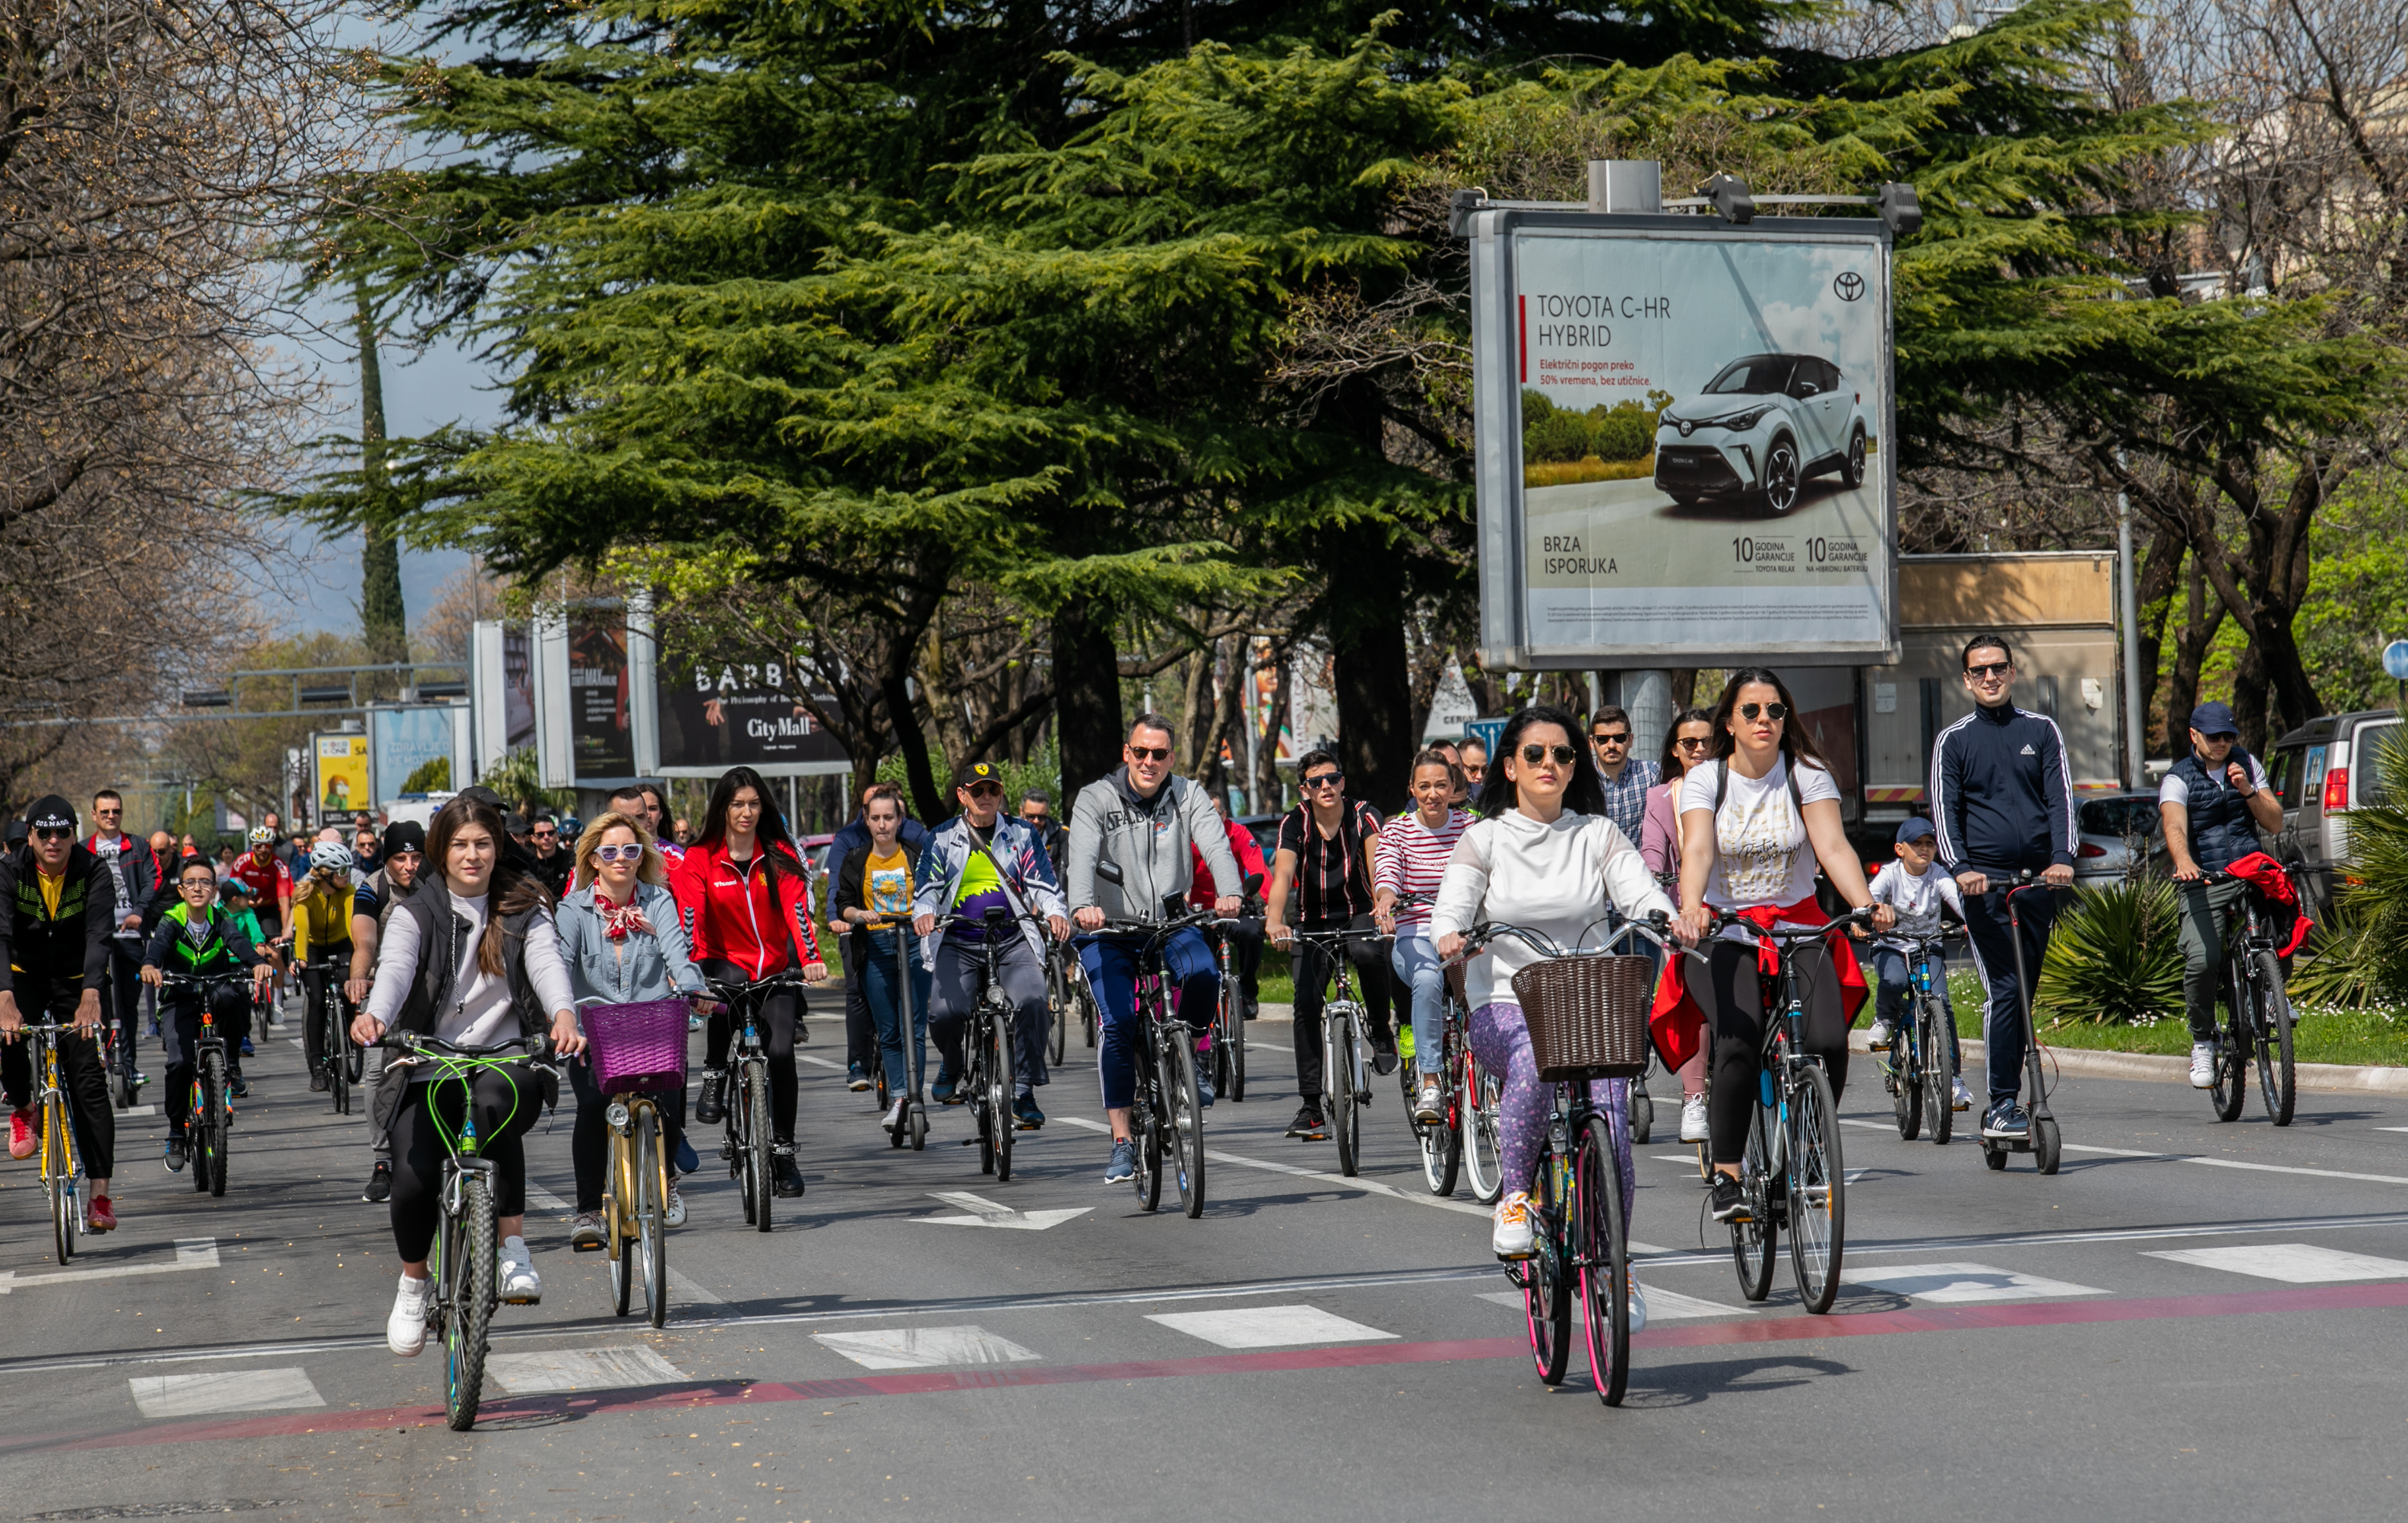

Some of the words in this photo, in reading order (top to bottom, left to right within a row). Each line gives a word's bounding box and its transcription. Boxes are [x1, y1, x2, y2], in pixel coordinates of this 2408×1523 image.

[1537, 294, 1614, 318] TOYOTA
[1621, 296, 1671, 319] C-HR
[1539, 324, 1612, 347] HYBRID
[1540, 359, 1580, 370] Električni
[1581, 361, 1609, 372] pogon
[1610, 359, 1634, 372] preko
[1540, 375, 1558, 385] 50%
[1560, 376, 1598, 387] vremena,
[1601, 375, 1616, 385] bez
[1544, 536, 1581, 552] BRZA
[1732, 537, 1754, 562] 10
[1755, 542, 1785, 551] GODINA
[1805, 537, 1826, 562] 10
[1828, 542, 1858, 551] GODINA
[1755, 552, 1795, 562] GARANCIJE
[1828, 552, 1868, 562] GARANCIJE
[1545, 558, 1617, 574] ISPORUKA
[35, 818, 70, 827] COLNAGO
[1759, 840, 1805, 869] energy
[702, 1070, 726, 1078] REPLAY
[776, 1145, 801, 1154] REPLAY
